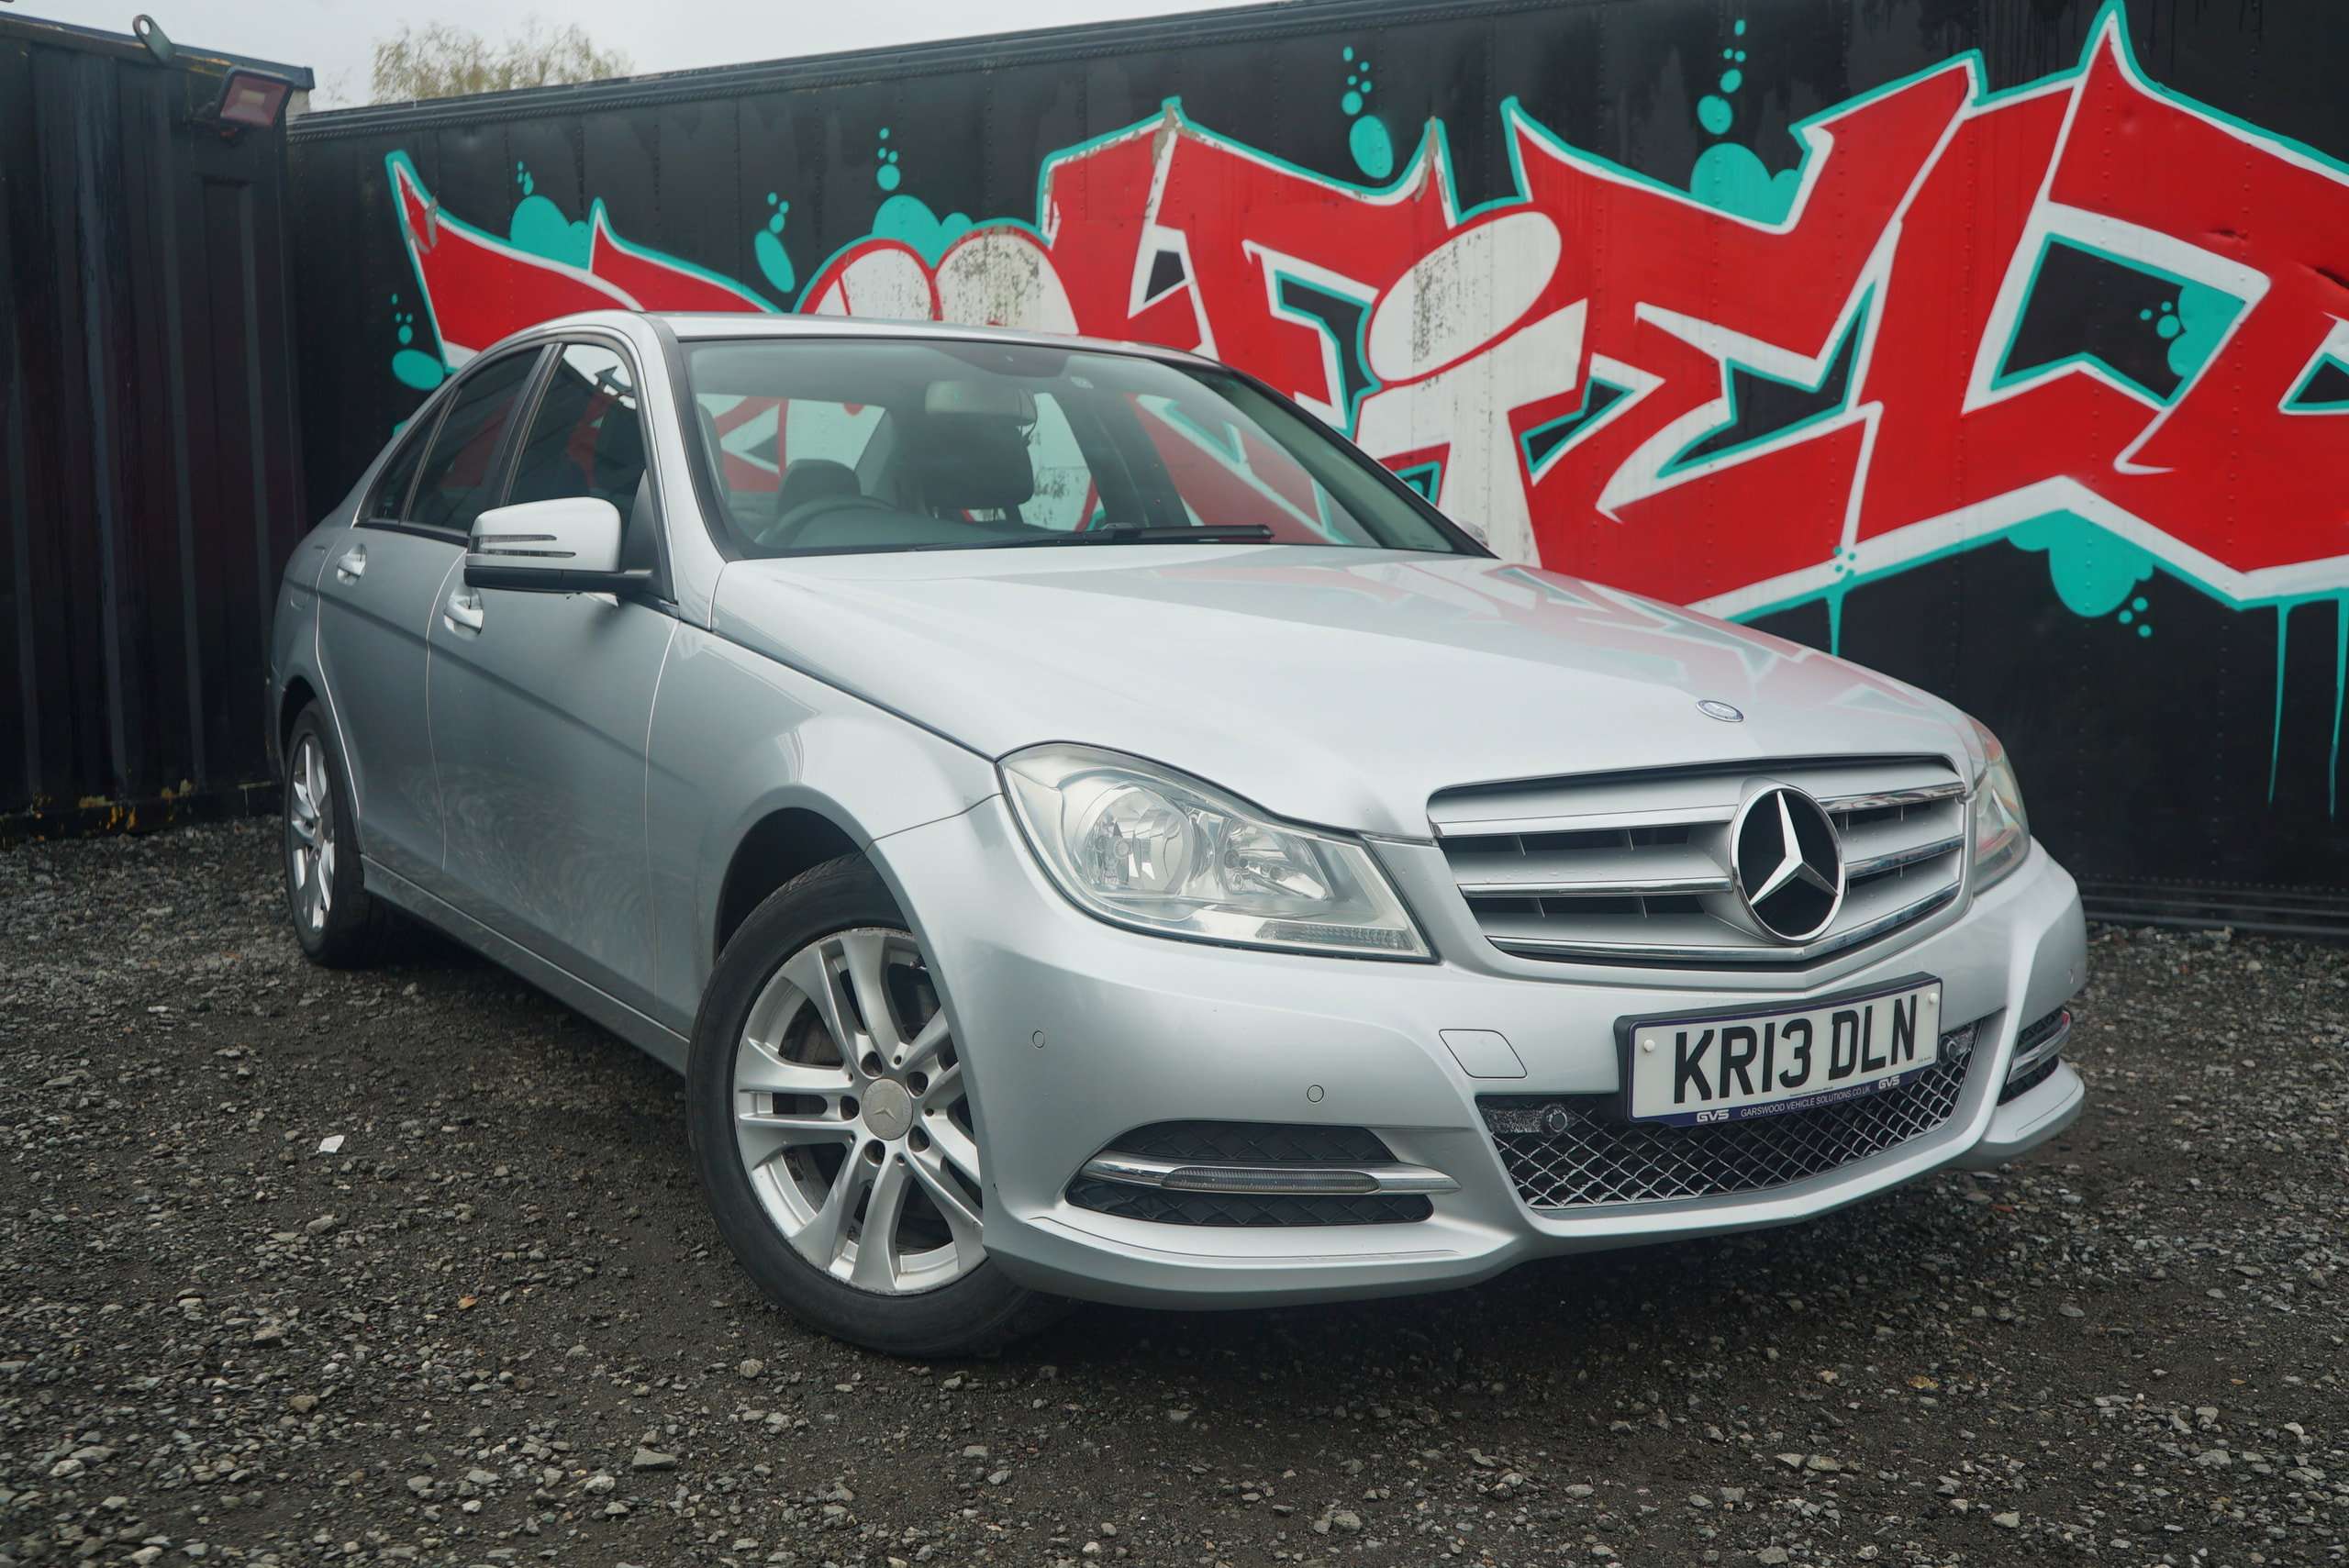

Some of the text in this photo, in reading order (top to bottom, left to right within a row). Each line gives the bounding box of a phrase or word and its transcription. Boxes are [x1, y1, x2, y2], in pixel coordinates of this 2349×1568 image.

[1674, 994, 1917, 1104] KR13 DLN
[1878, 1074, 1900, 1089] GVS
[1740, 1103, 1785, 1118] GARSWOOD
[1787, 1097, 1815, 1110] VEHICLE
[1816, 1090, 1851, 1103] SOLUTIONS
[1697, 1109, 1730, 1122] GVS
